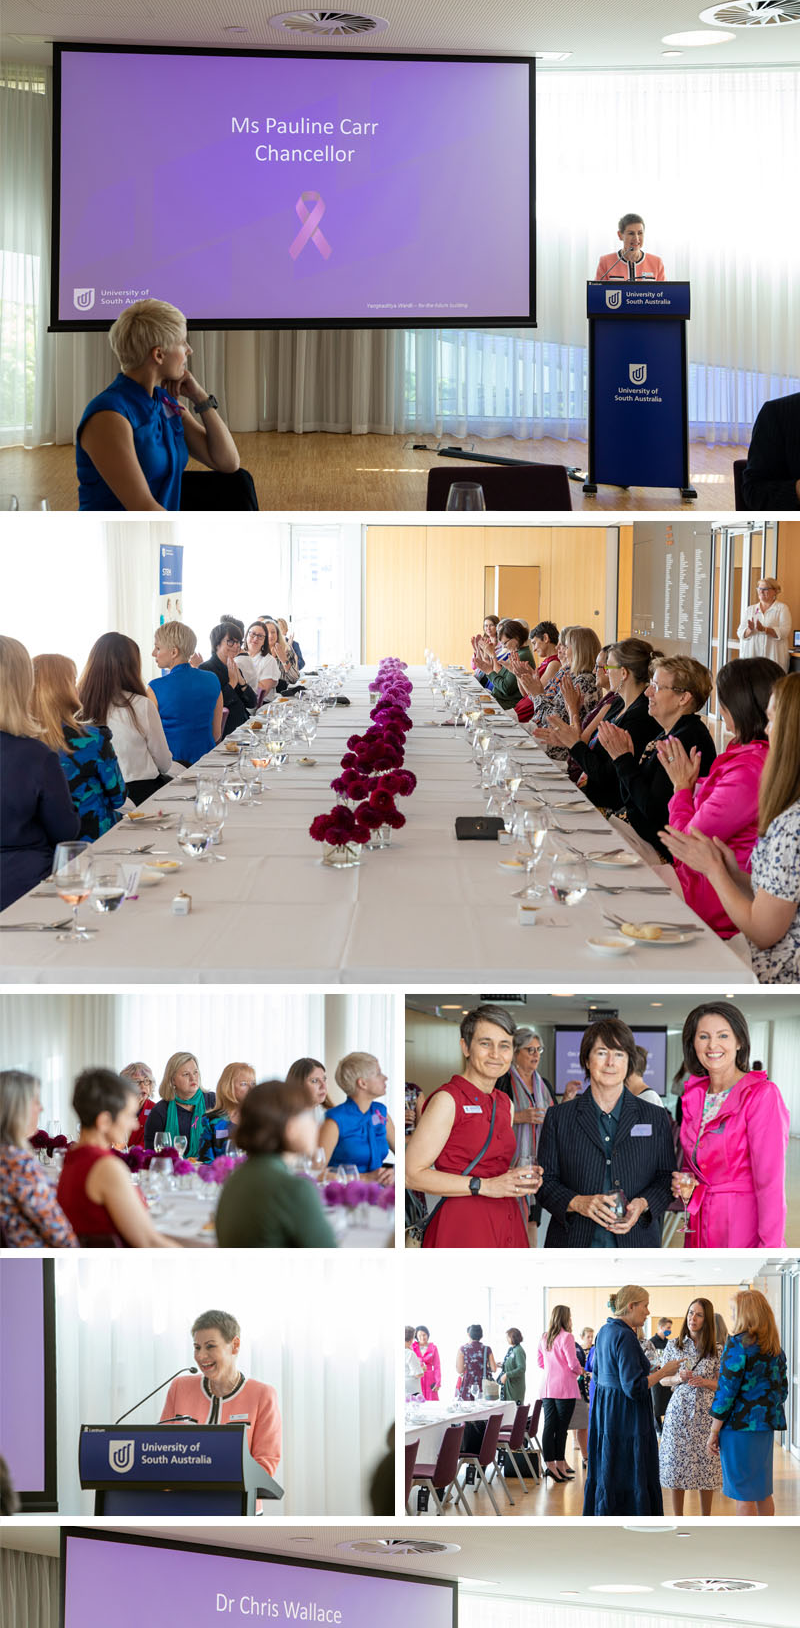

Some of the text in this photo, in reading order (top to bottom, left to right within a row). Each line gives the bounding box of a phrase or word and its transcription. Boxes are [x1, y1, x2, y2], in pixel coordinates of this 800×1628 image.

[231, 117, 379, 135] Ms Pauline Carr
[255, 144, 355, 162] Chancellor
[141, 1442, 200, 1453] University of
[141, 1455, 212, 1464] South Australia
[216, 1593, 342, 1624] Dr Chris Wallace
